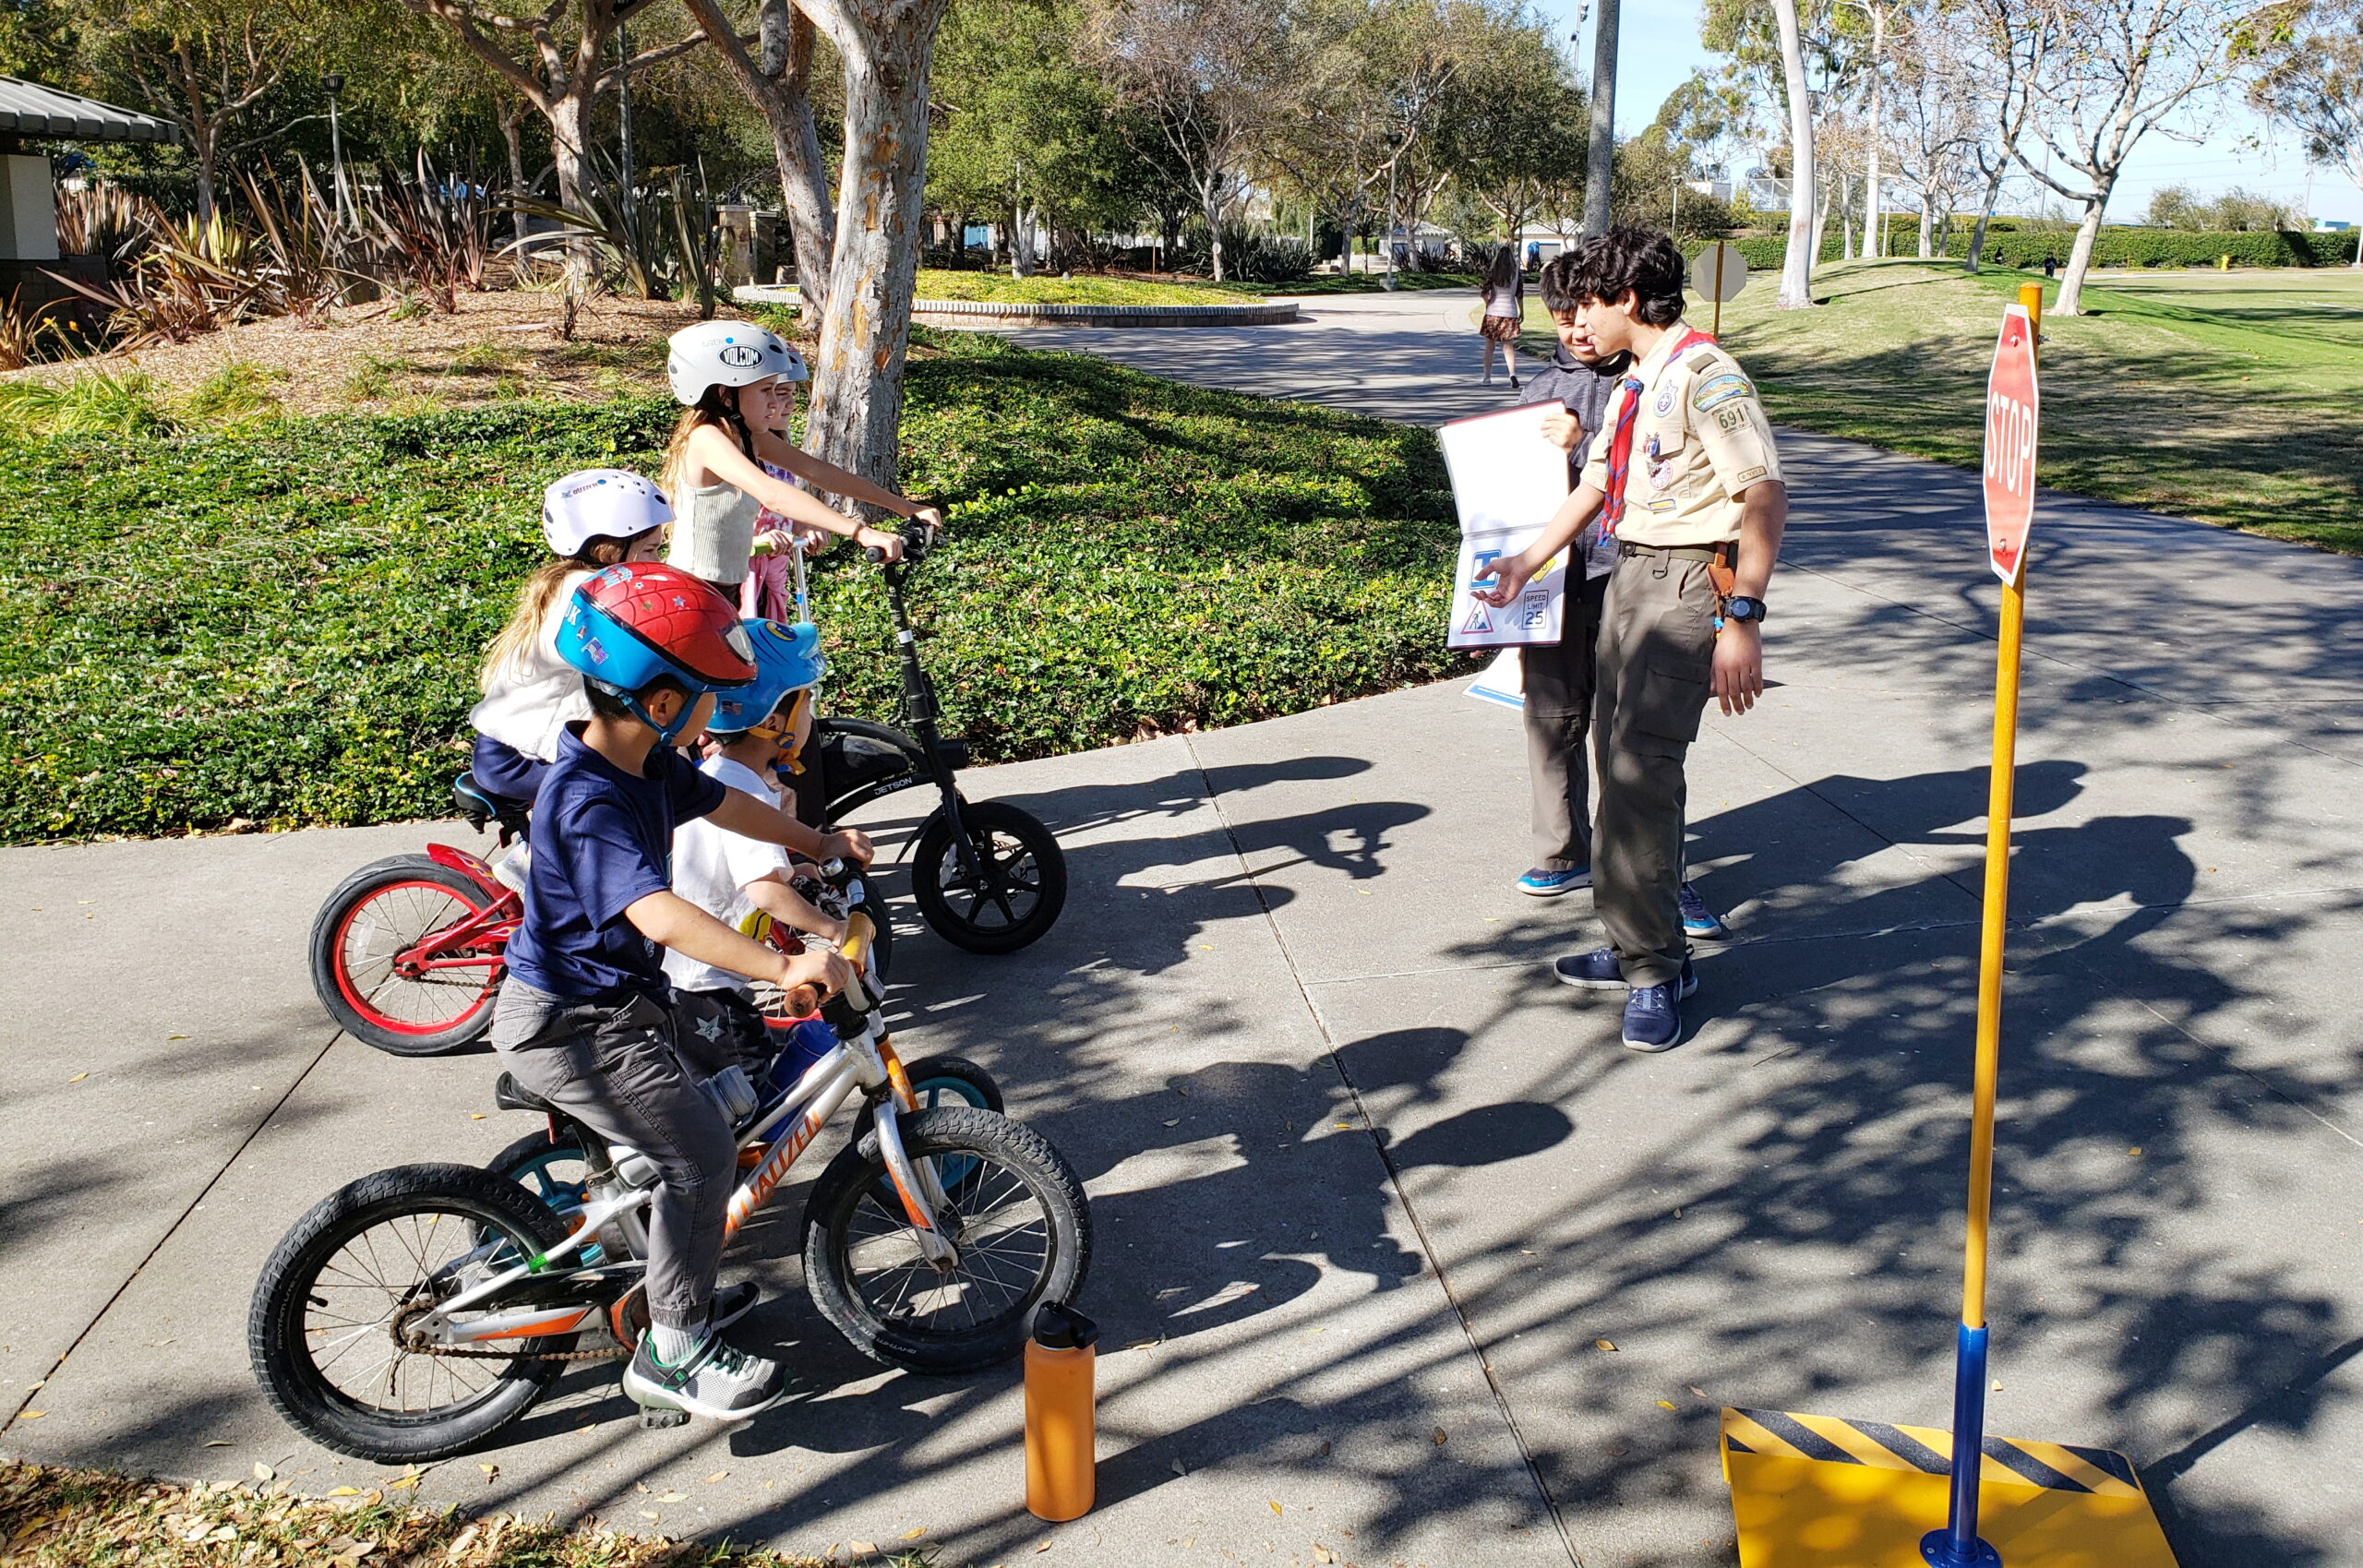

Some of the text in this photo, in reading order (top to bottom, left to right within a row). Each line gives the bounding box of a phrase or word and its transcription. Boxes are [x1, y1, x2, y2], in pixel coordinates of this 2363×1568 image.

[723, 346, 759, 366] VOLCOM
[1719, 407, 1745, 429] 691
[1986, 390, 2032, 497] STOP
[1526, 594, 1546, 603] SPEED
[1527, 602, 1544, 610] LIMIT
[1525, 611, 1543, 626] 25
[873, 776, 913, 796] JETSON
